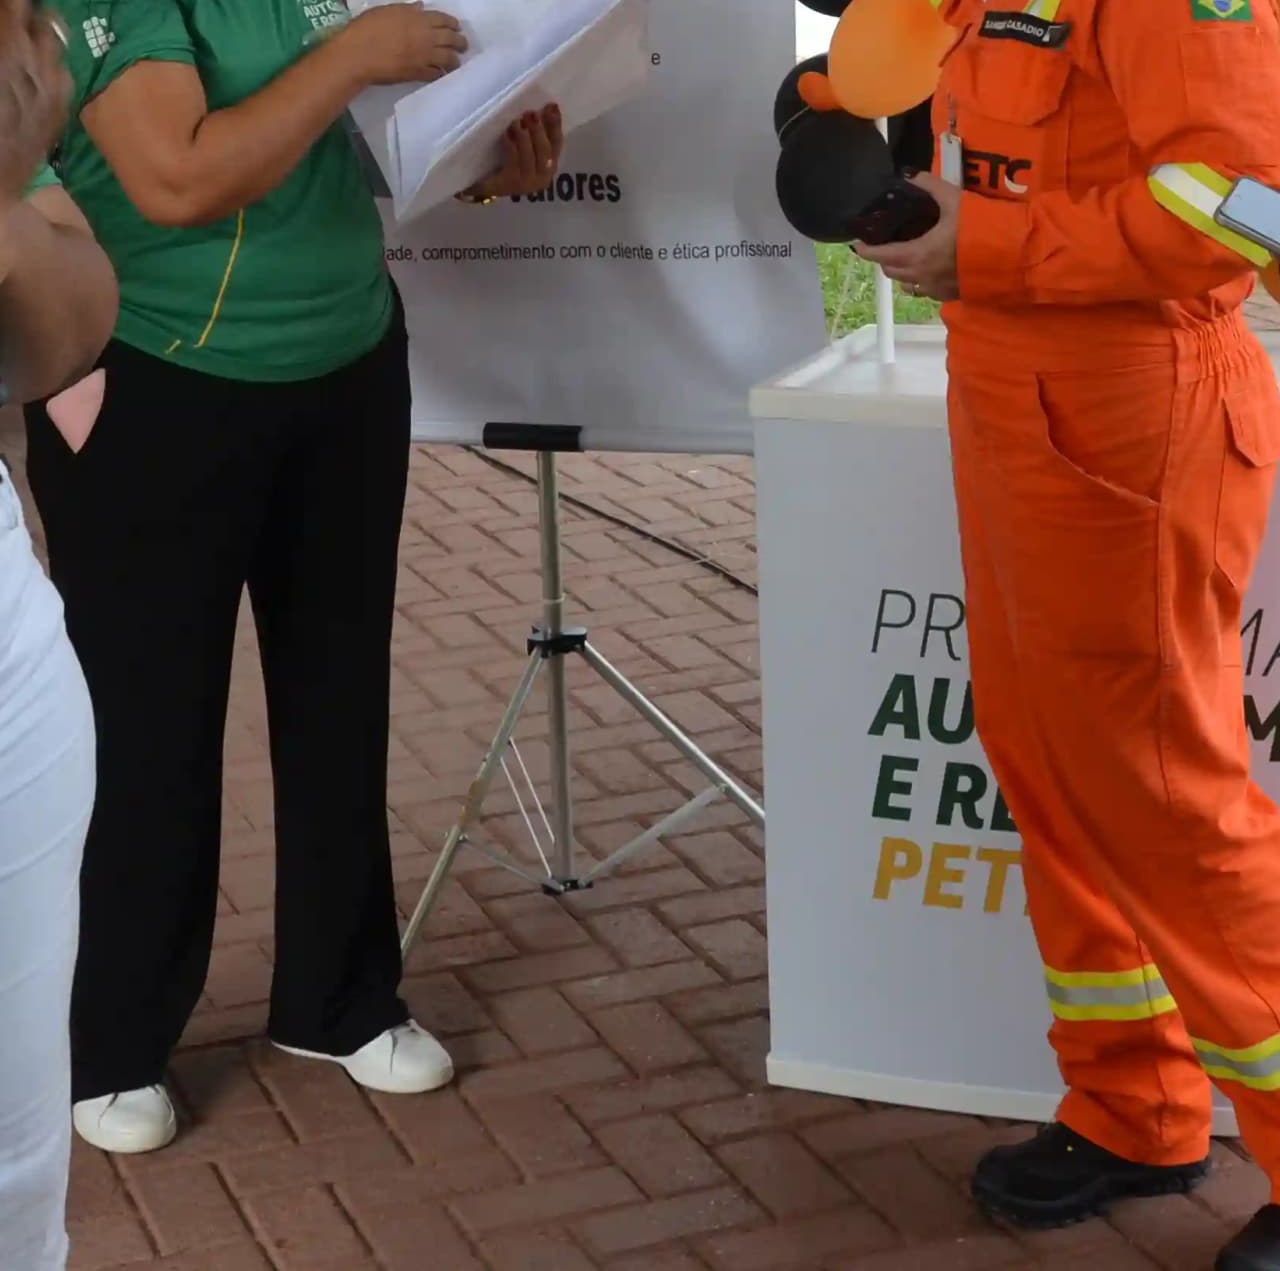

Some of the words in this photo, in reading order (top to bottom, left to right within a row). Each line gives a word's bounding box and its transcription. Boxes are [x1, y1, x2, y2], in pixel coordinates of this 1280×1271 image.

[651, 52, 661, 66] e
[384, 245, 417, 263] ade,
[422, 242, 556, 266] comprometimento
[560, 243, 592, 261] com
[596, 246, 606, 259] o
[611, 240, 654, 261] cliente
[658, 246, 668, 260] e
[673, 242, 710, 261] ética
[715, 240, 792, 264] profissional
[872, 755, 919, 820] E
